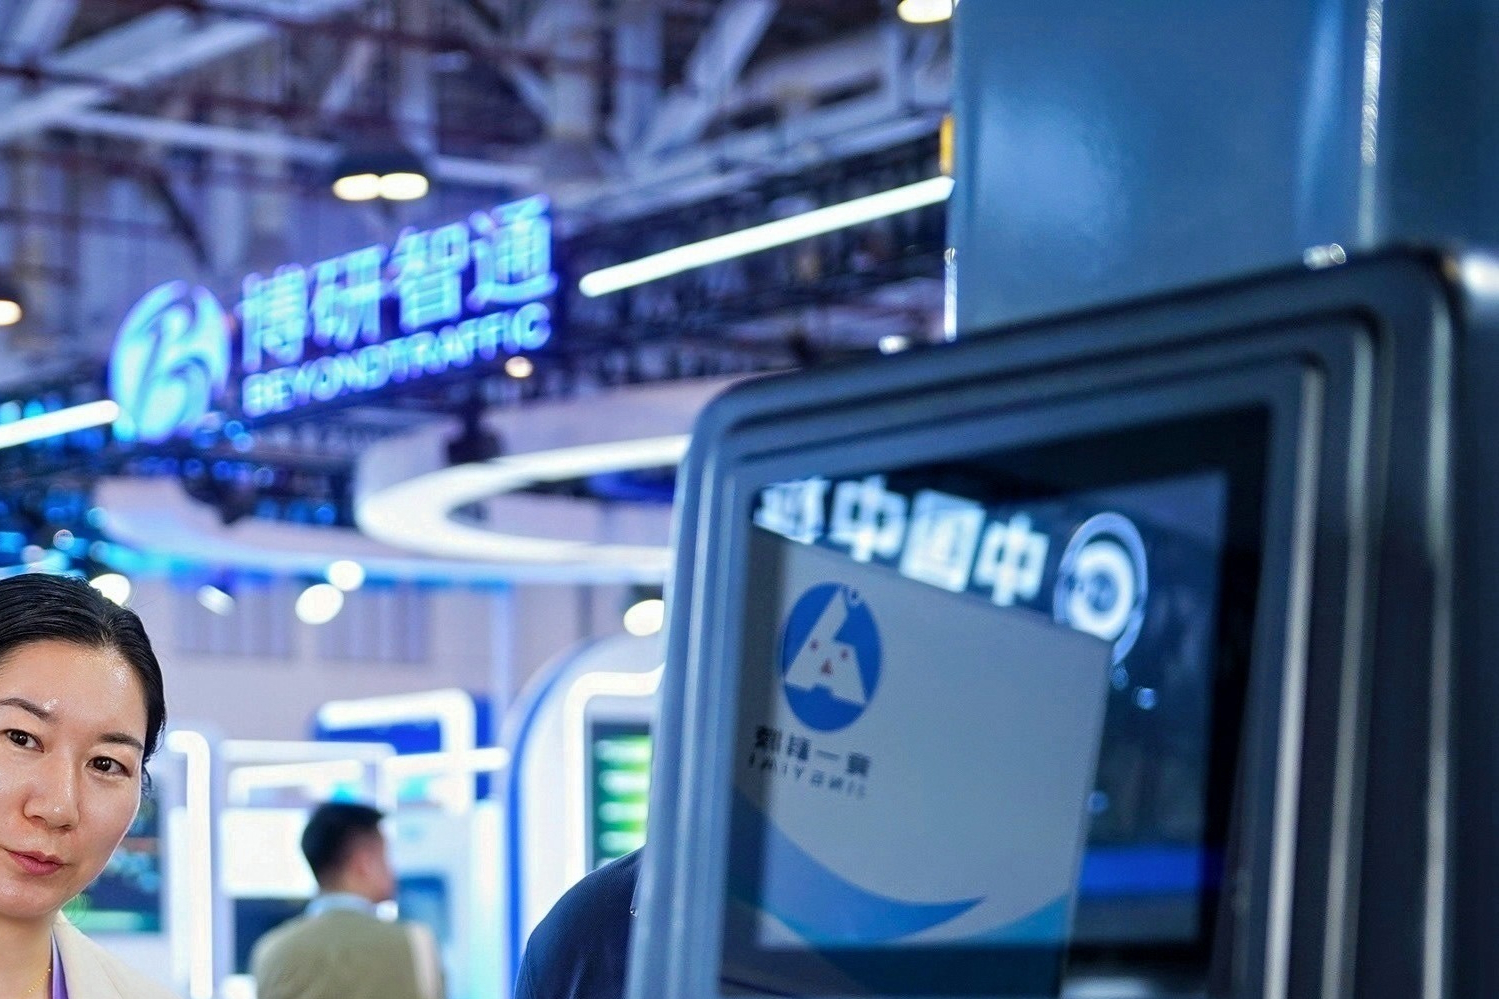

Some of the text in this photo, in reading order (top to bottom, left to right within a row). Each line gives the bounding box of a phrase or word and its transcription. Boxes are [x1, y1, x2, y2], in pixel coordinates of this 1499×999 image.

[234, 193, 558, 374] 博研智通
[242, 302, 551, 418] BEYONDTRAFFIC
